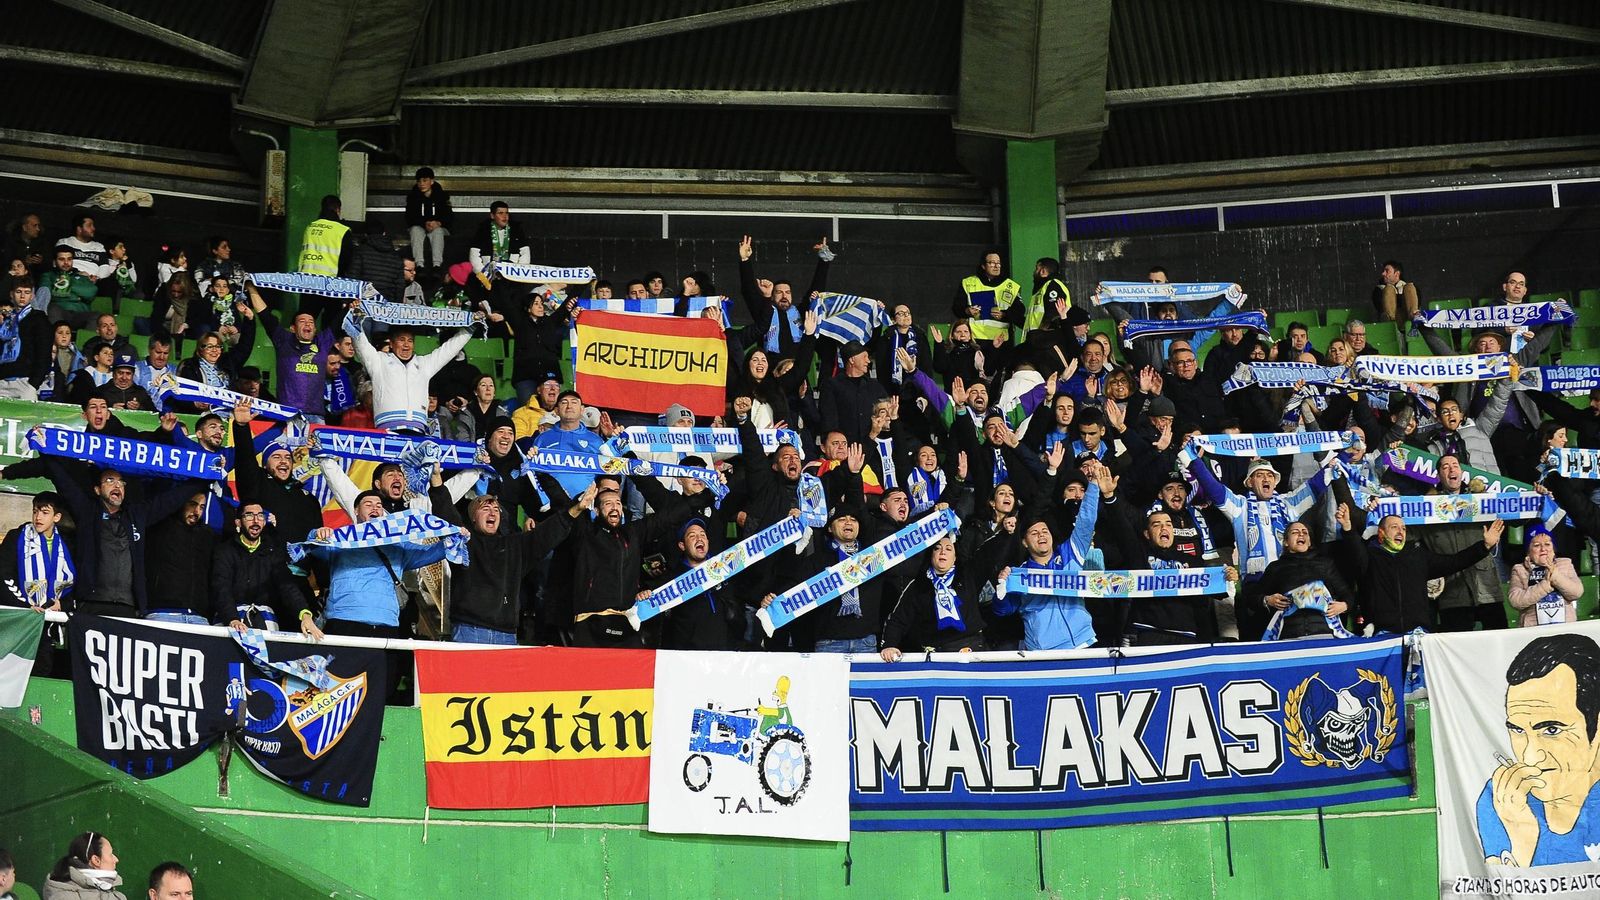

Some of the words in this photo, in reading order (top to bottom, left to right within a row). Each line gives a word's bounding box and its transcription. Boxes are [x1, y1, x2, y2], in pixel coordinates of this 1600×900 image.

[505, 265, 590, 279] INVENCIBLES
[370, 304, 398, 318] 100%
[400, 307, 465, 321] MALAGUISTA
[1445, 303, 1541, 323] Malaga
[1366, 361, 1474, 376] INVENCIBLES
[1551, 380, 1598, 389] Orgullo
[332, 433, 460, 464] MALAA
[633, 432, 656, 444] UNA
[659, 432, 691, 445] COSA
[1221, 438, 1254, 451] COSA
[1256, 431, 1335, 449] INEXPLICABLE
[56, 430, 207, 474] SUPERBASTI
[531, 452, 597, 470] MALAKA
[662, 466, 720, 484] HINCHA
[1481, 496, 1541, 515] HINCHA
[334, 513, 449, 543] MALAG
[780, 572, 844, 615] MALAKA
[884, 512, 950, 557] HINCHAS
[649, 567, 708, 609] MALAKA
[1020, 573, 1087, 590] MALAKA
[1137, 573, 1210, 591] HINCHAS
[85, 628, 205, 710] SUPER
[296, 694, 338, 723] MALAGA
[337, 683, 355, 697] C.F.
[99, 688, 199, 750] BASTI
[446, 695, 651, 757] Istán
[850, 679, 1285, 793] MALAKAS
[714, 796, 778, 815] J.A.L.
[1505, 879, 1547, 894] HORAS
[1550, 877, 1568, 892] DE
